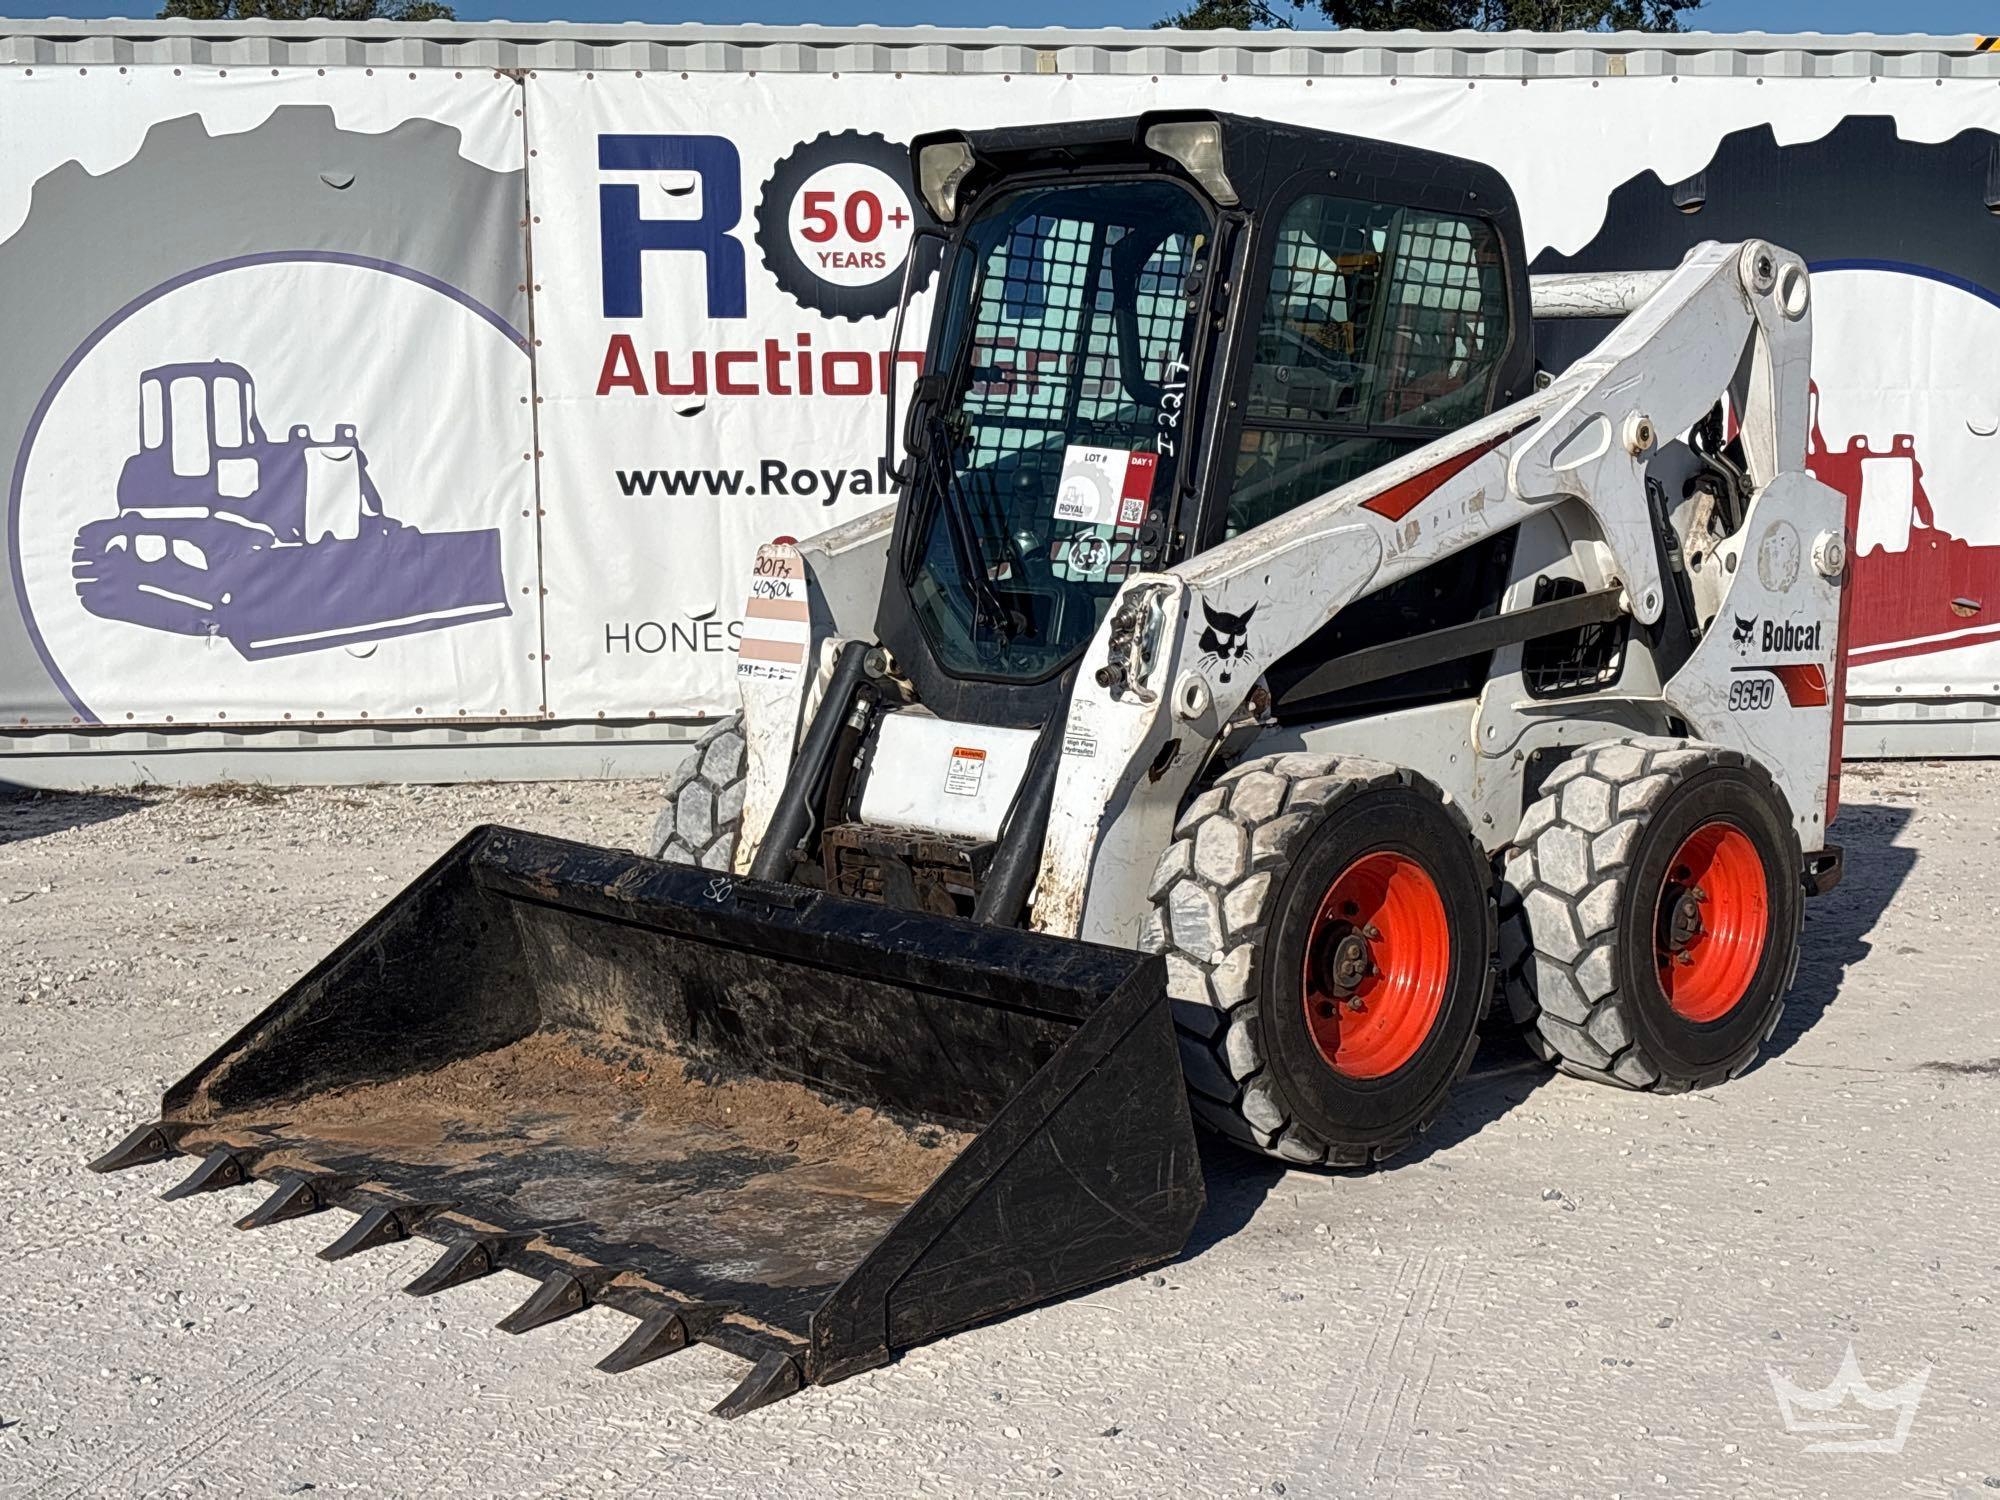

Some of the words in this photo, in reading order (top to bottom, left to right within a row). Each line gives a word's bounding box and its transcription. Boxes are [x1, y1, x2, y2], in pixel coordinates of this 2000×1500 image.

[800, 190, 910, 243] 50+
[816, 251, 887, 269] YEARS
[1085, 453, 1101, 463] LOT
[1131, 457, 1147, 466] DAY
[1148, 459, 1153, 467] 1
[615, 457, 906, 507] www.Royal
[1059, 503, 1084, 514] ROYAL
[1762, 619, 1821, 652] Bobcat
[1728, 678, 1775, 712] S650
